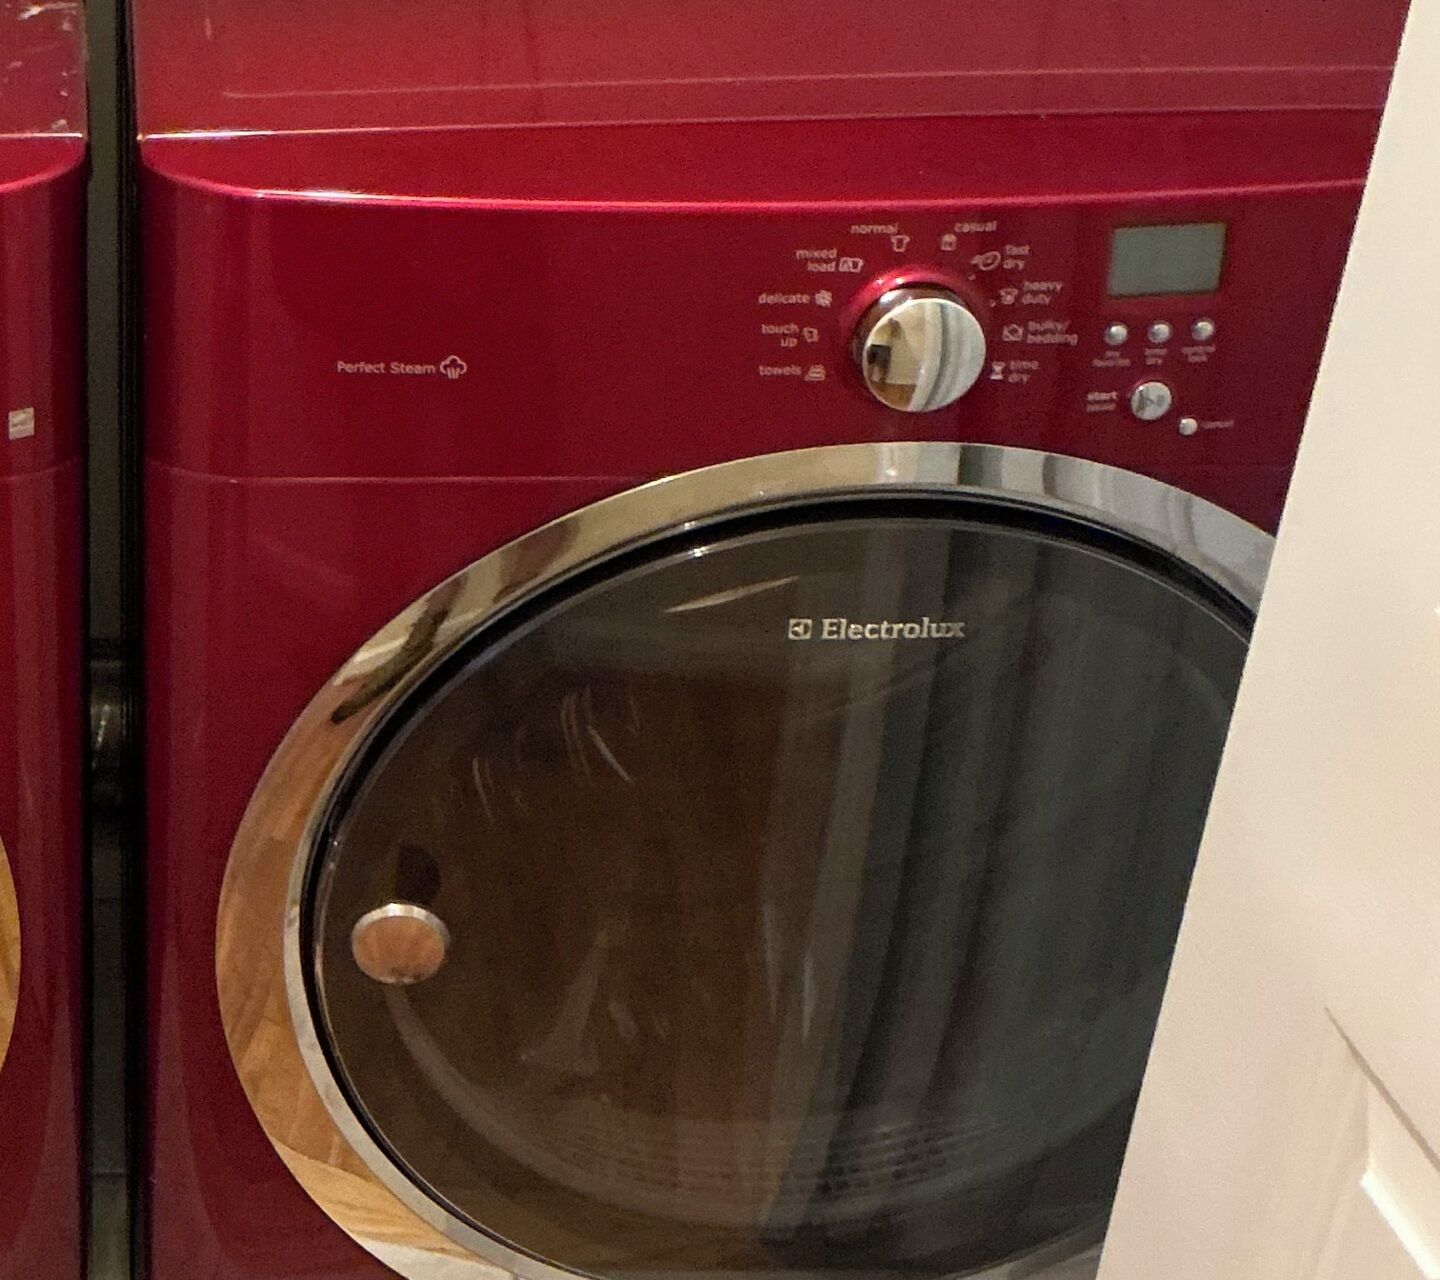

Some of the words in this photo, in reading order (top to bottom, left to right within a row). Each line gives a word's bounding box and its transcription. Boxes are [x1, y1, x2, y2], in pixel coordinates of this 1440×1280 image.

[850, 222, 898, 235] normal
[954, 220, 998, 233] casual
[795, 248, 838, 260] mixed
[807, 261, 836, 272] load
[758, 293, 811, 304] delicate
[761, 322, 800, 334] touch
[780, 337, 798, 348] up
[337, 360, 385, 374] Perfect
[389, 361, 436, 375] Steam
[758, 364, 802, 376] towels
[821, 616, 966, 640] Electrolux
